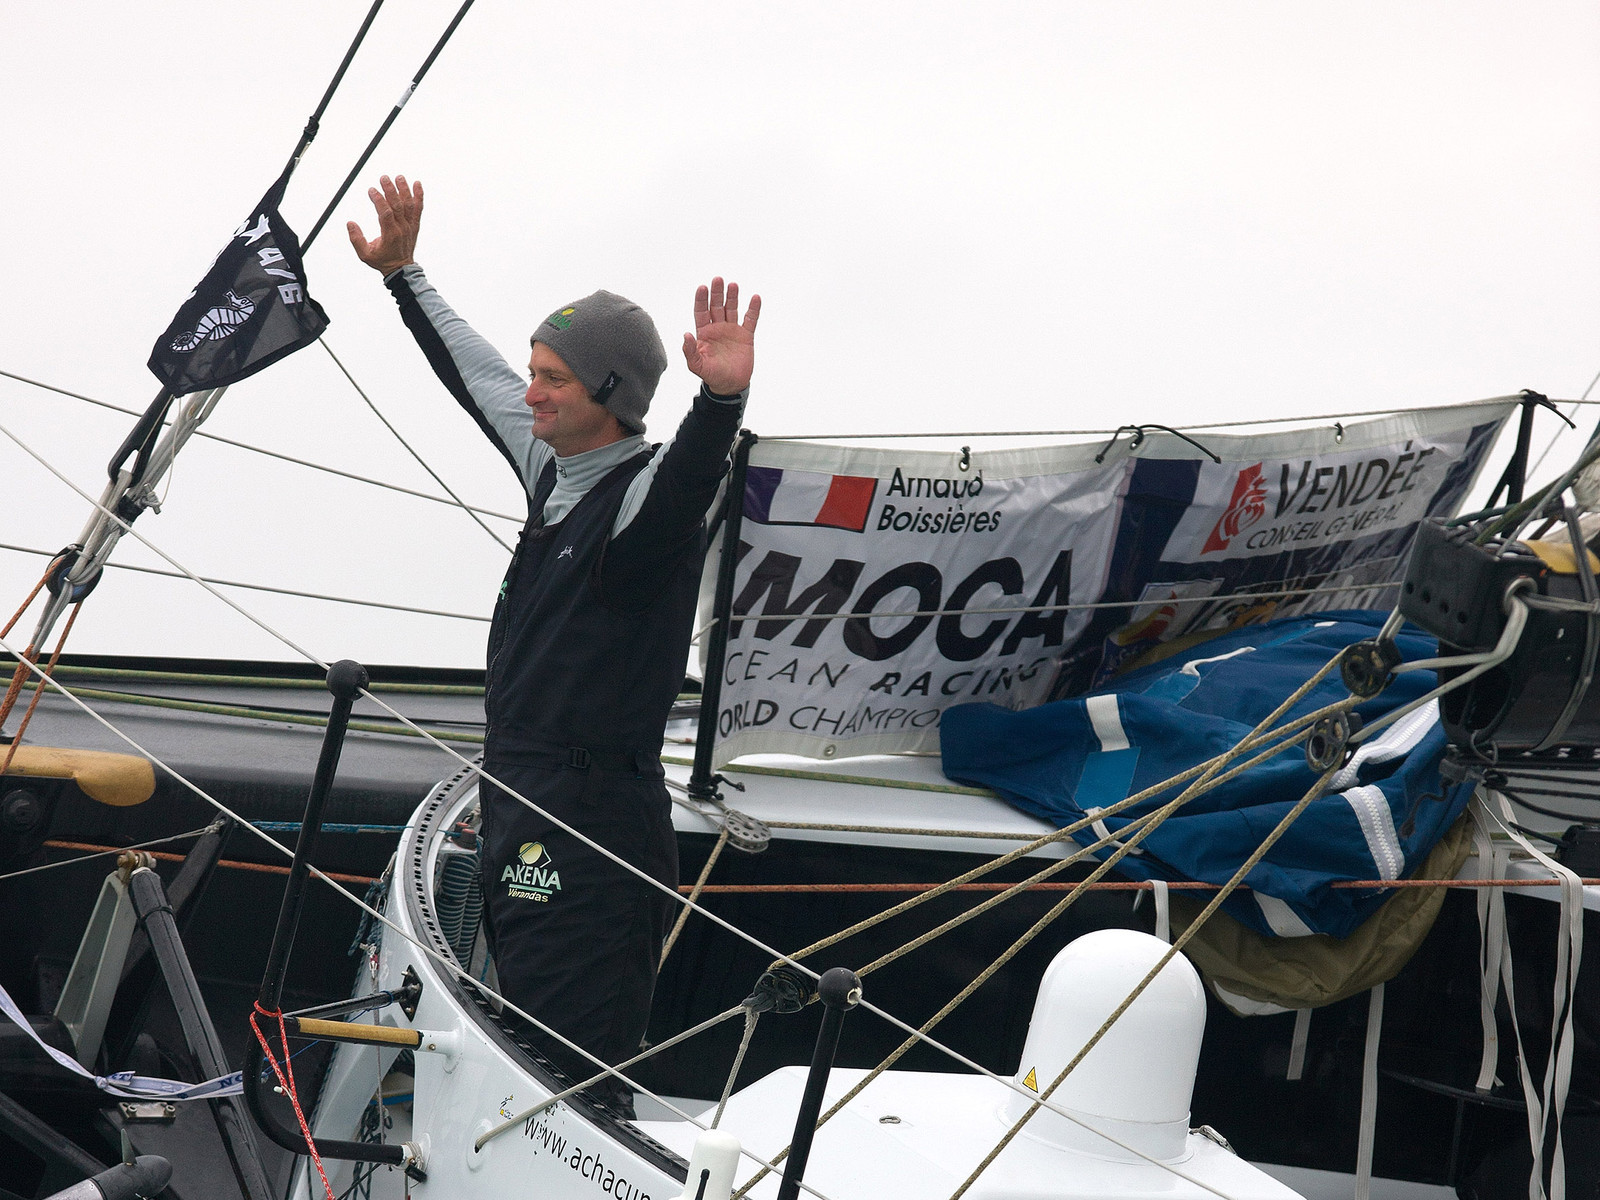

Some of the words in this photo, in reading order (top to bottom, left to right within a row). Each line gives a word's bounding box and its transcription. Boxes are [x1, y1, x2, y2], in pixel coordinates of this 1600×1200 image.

[886, 467, 984, 499] Arnaud
[1274, 440, 1436, 519] VENDÉE
[877, 503, 1002, 534] Boissières
[729, 540, 1074, 662] MOCA
[725, 651, 849, 688] CEAN
[870, 657, 1048, 697] RACING
[717, 700, 780, 738] ORLD
[788, 704, 942, 737] CHAMPIO
[500, 864, 562, 891] AKENA
